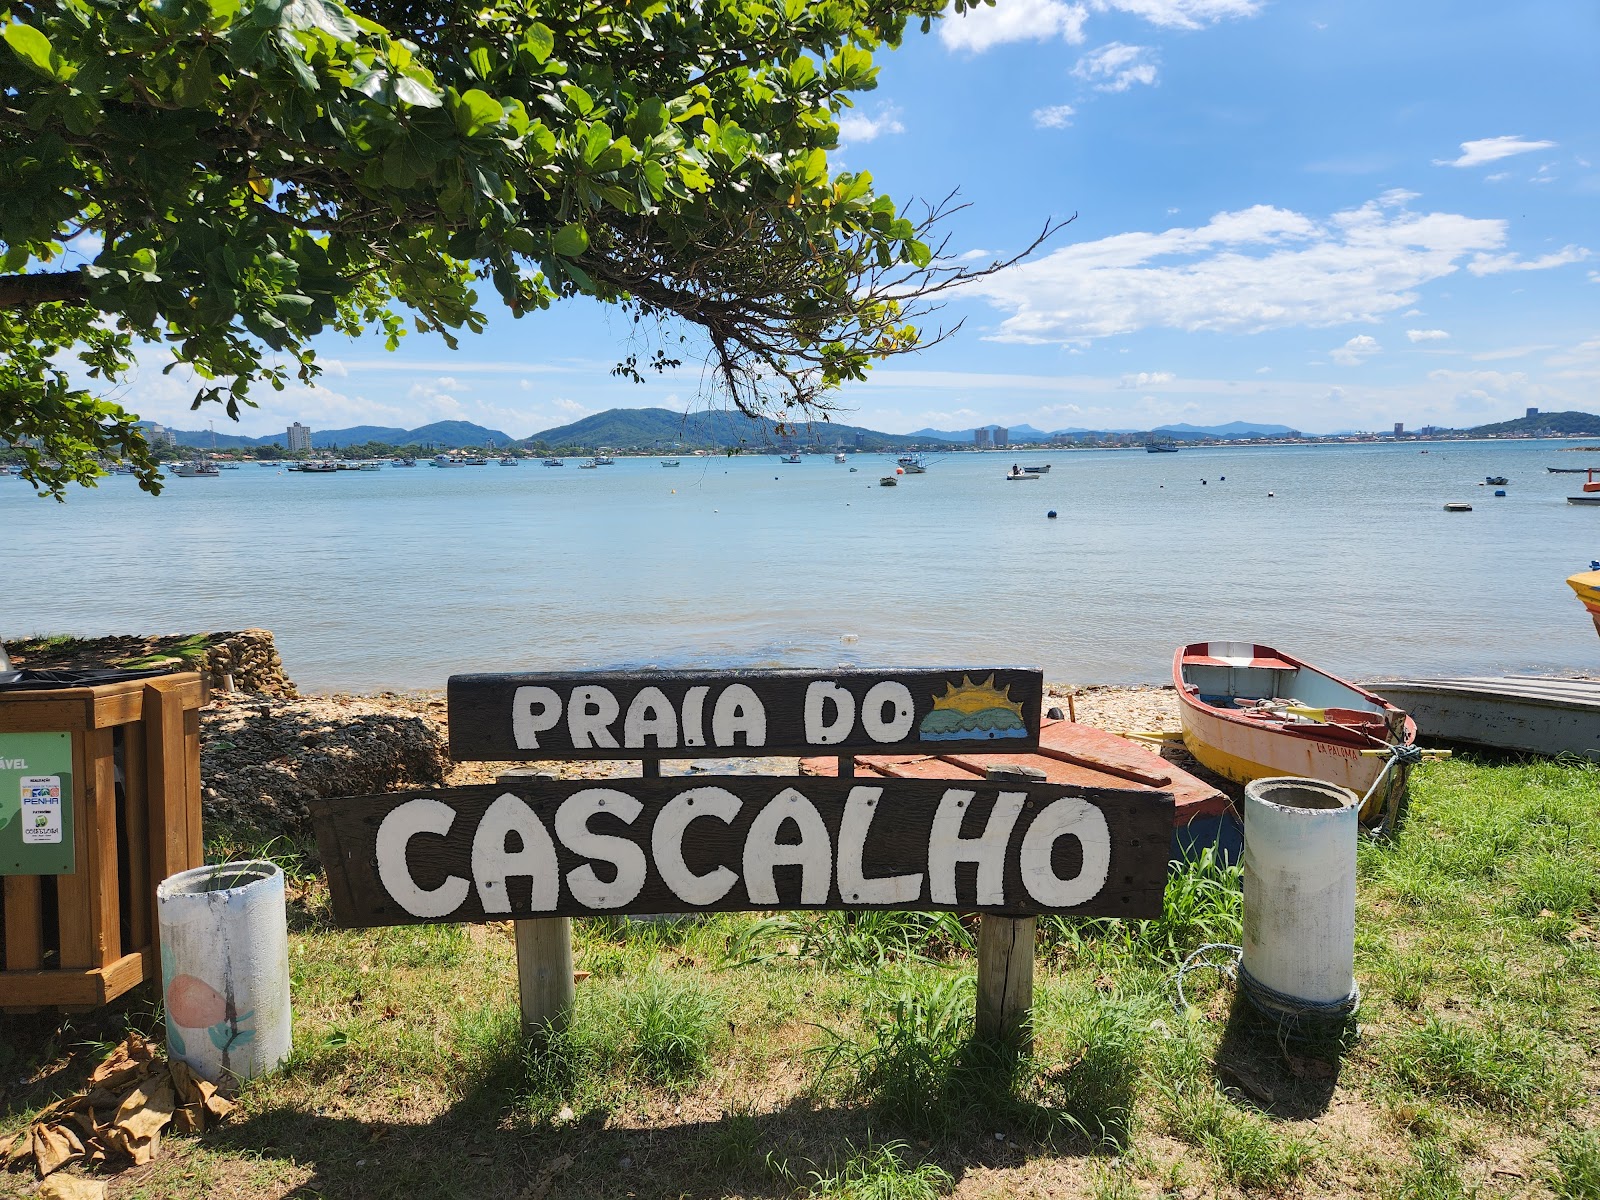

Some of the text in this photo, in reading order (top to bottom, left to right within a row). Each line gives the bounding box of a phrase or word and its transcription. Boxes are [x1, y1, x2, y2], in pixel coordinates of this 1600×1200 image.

[512, 680, 915, 750] PRAIA DO
[1316, 742, 1358, 761] LA PALOMA
[23, 797, 59, 805] PENHA
[375, 785, 1112, 918] CASCALHO
